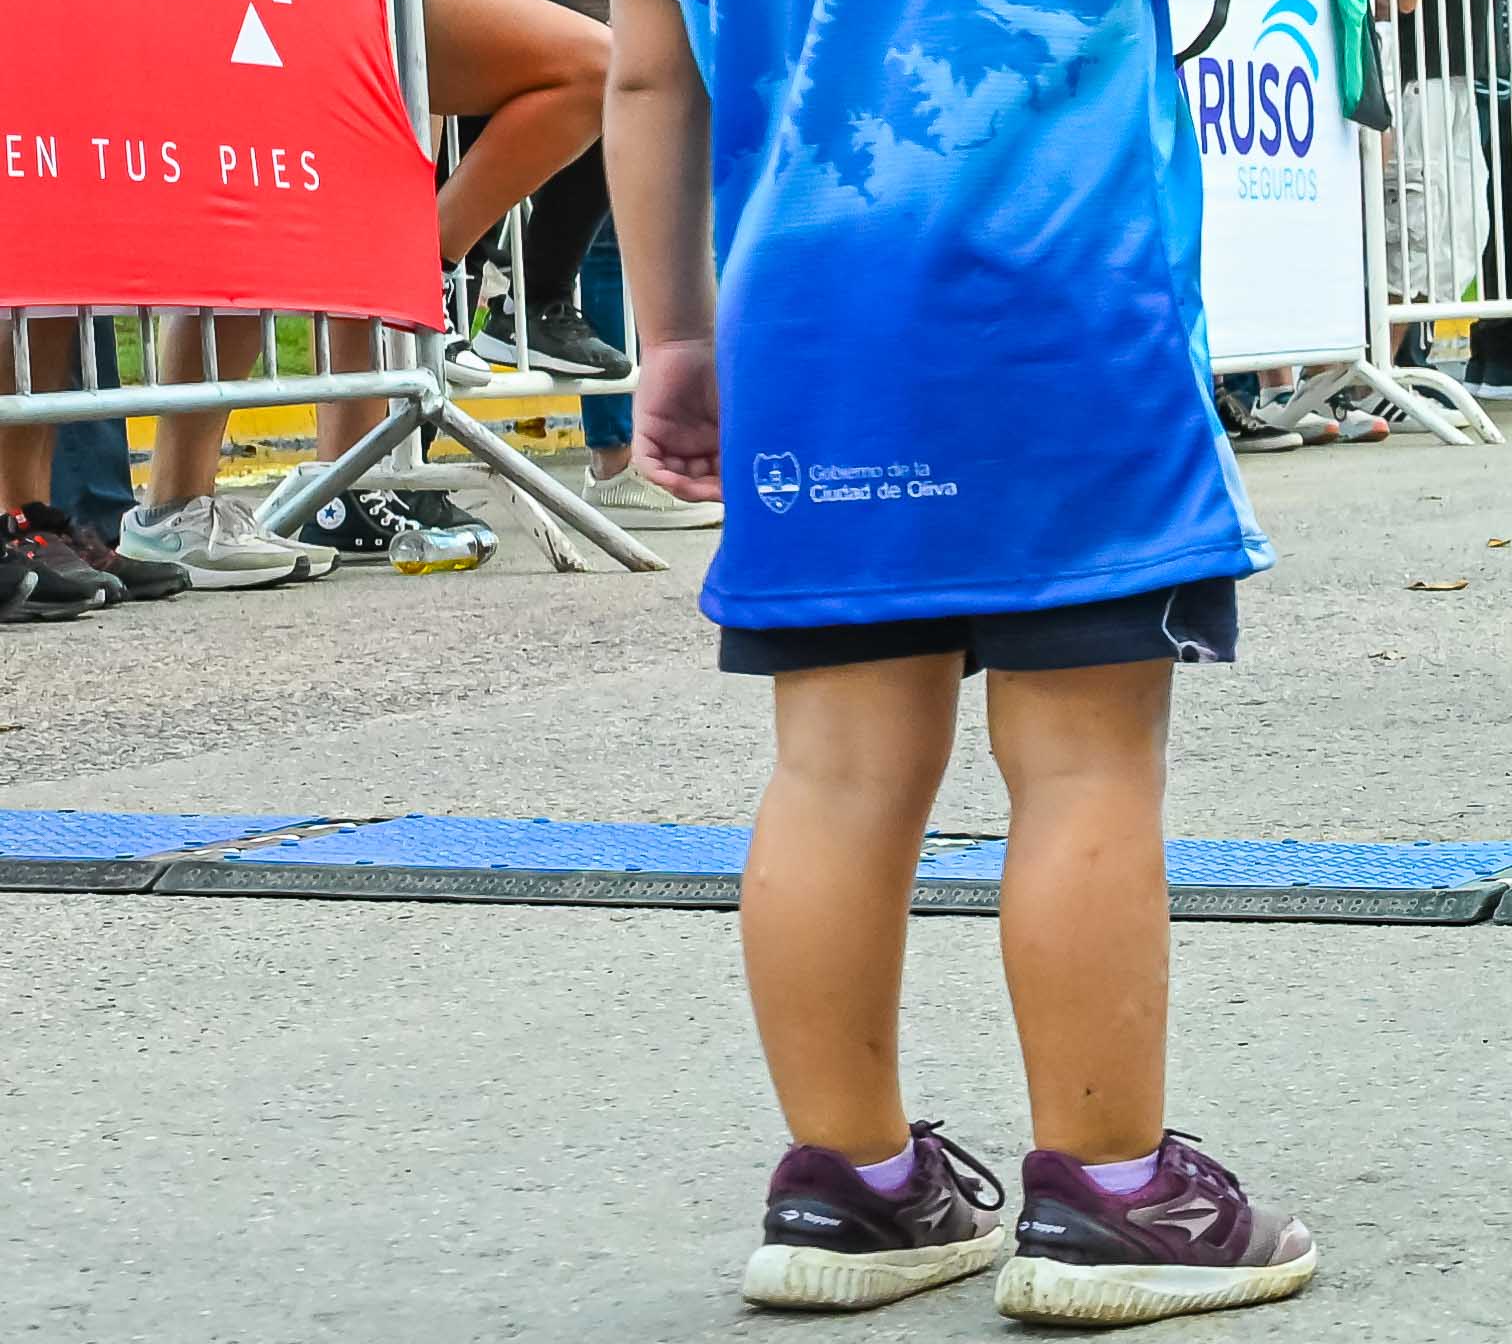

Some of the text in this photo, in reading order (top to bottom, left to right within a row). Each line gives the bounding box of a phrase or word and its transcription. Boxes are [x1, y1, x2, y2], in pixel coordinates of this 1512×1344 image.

[1176, 57, 1314, 158] RUSO
[92, 138, 182, 183] TUS
[220, 145, 321, 191] PIES
[1237, 166, 1317, 201] SEGUROS
[914, 461, 930, 477] la
[876, 482, 902, 499] de
